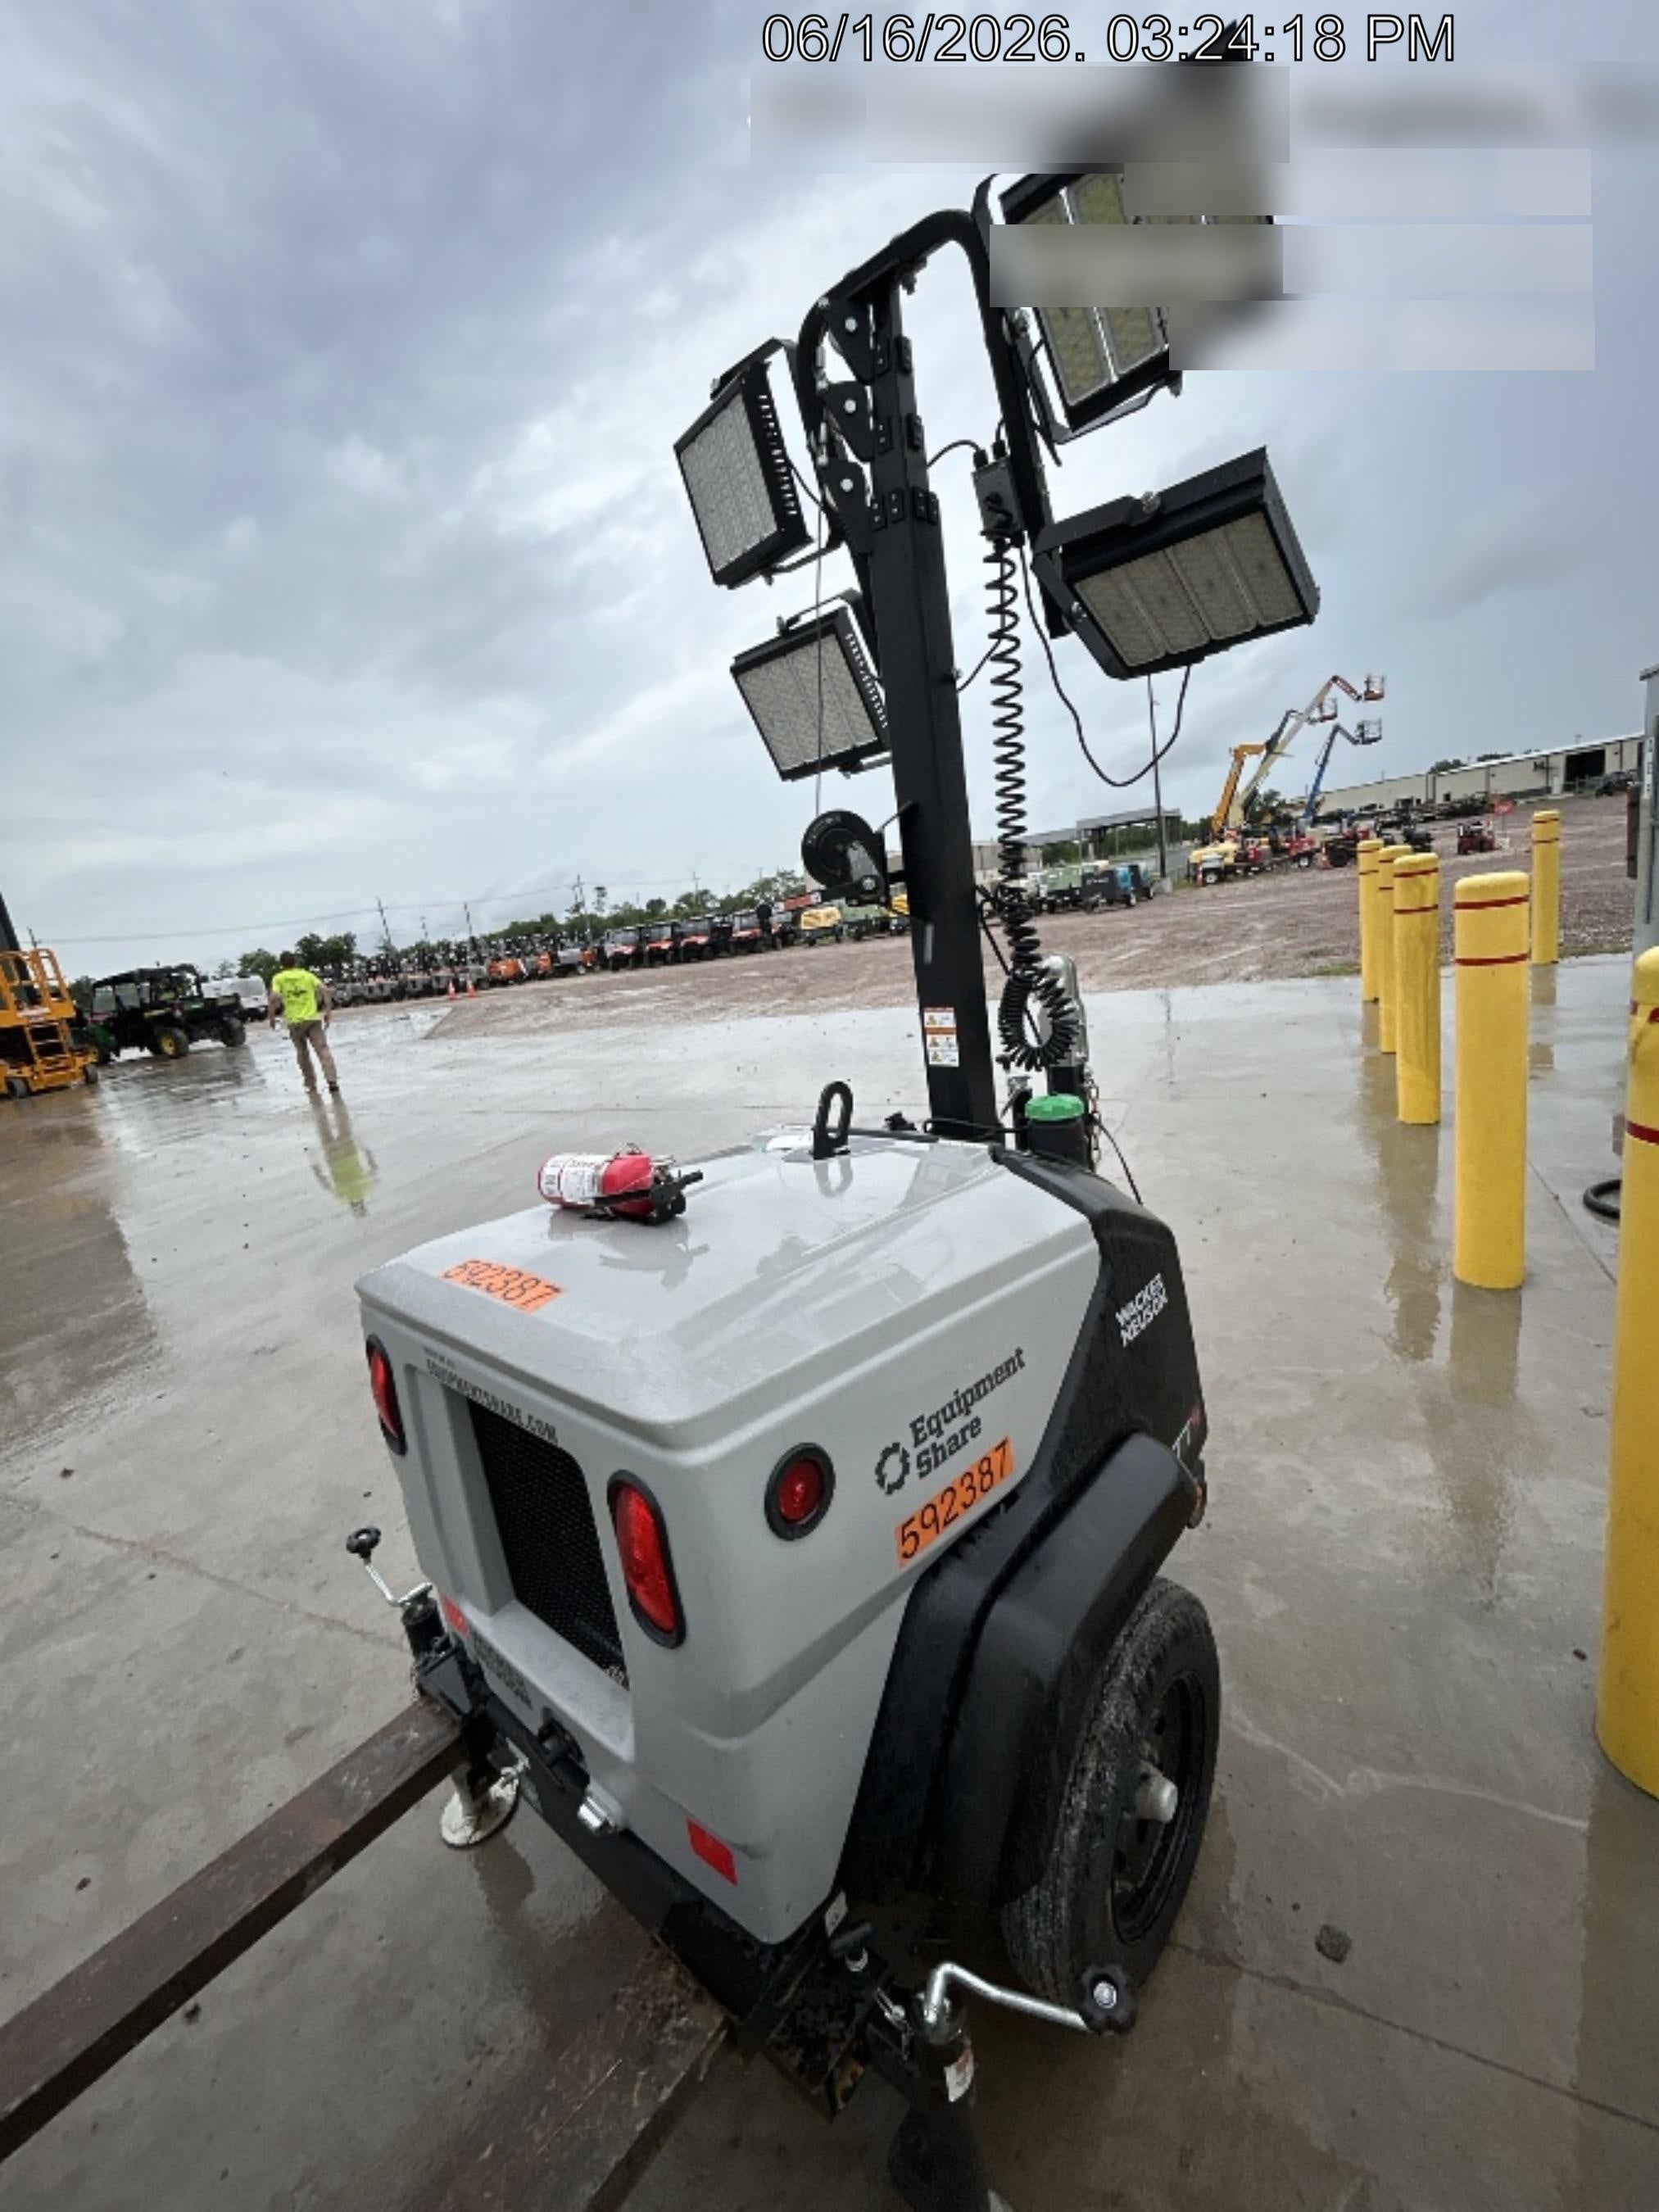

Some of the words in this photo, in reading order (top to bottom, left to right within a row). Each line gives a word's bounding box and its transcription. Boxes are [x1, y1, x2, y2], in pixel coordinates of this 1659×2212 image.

[443, 1259, 561, 1307] 592387
[909, 1346, 1026, 1448] Equipment
[916, 1415, 981, 1480] Share
[900, 1436, 1009, 1559] 592387
